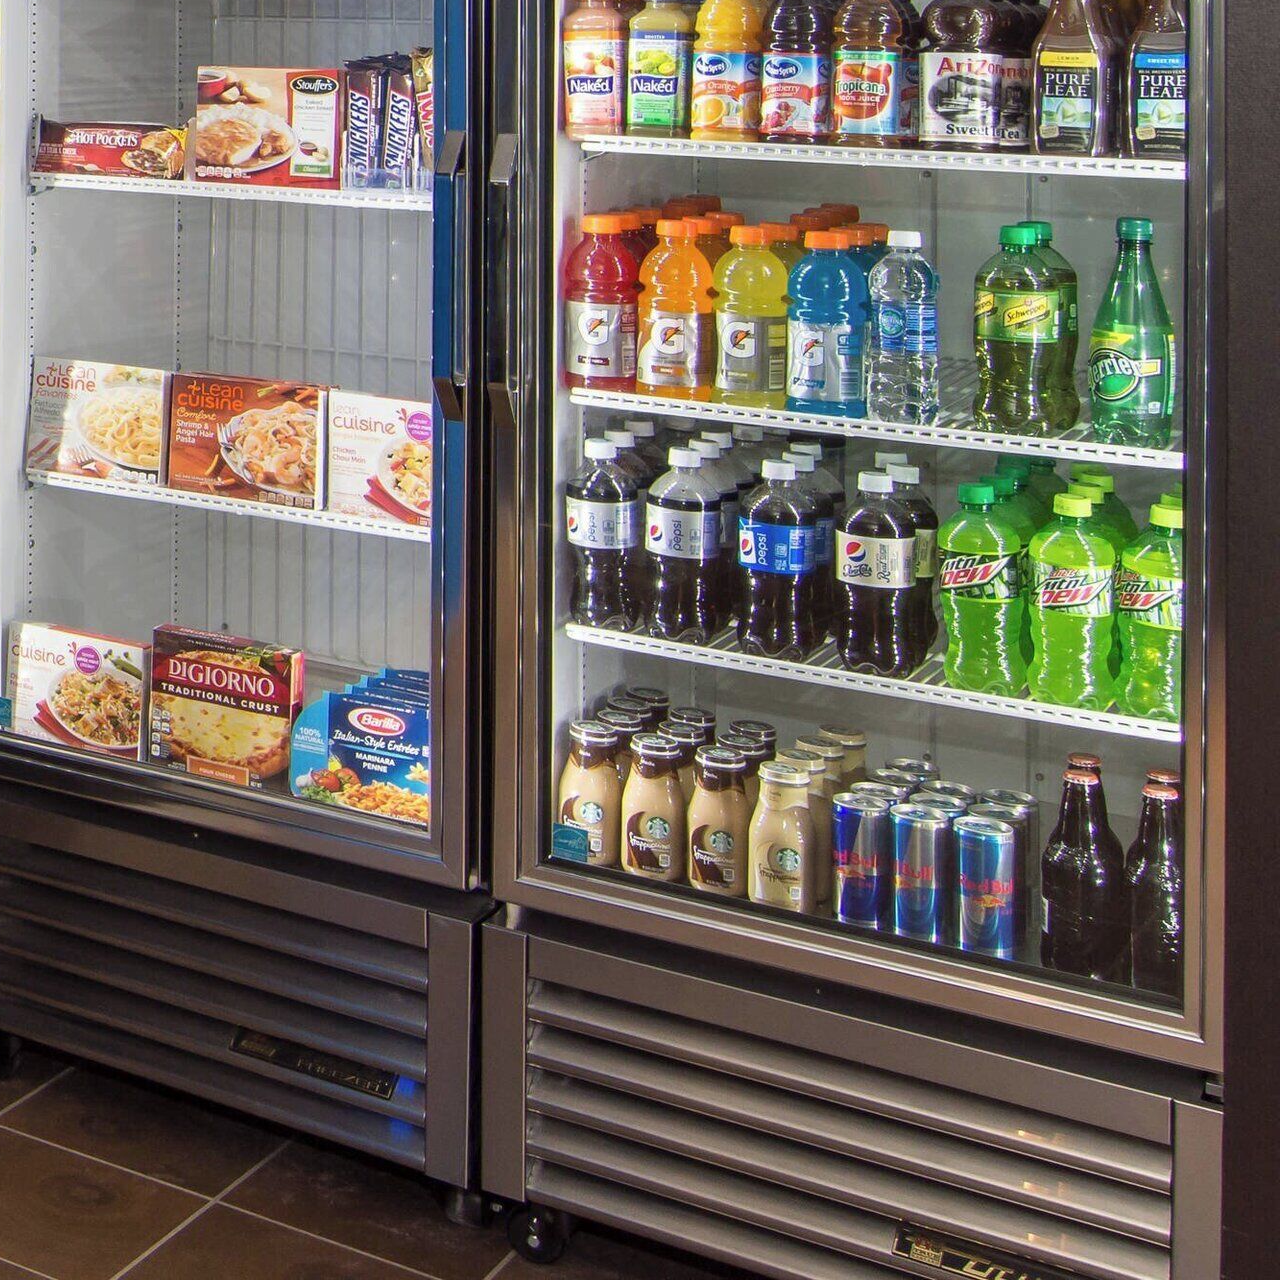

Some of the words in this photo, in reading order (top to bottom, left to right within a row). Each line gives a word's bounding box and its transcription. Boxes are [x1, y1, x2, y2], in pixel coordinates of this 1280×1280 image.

[936, 56, 1002, 77] AriZon
[295, 79, 333, 92] Stouffer's
[707, 80, 737, 92] Orange
[834, 78, 888, 96] Tropicana
[1044, 72, 1091, 86] PURE
[1139, 74, 1187, 87] PURE
[858, 95, 881, 103] JUICE
[1044, 84, 1088, 98] LEAF
[1139, 86, 1184, 99] LEAF
[75, 130, 97, 145] HOT
[96, 132, 138, 147] POCKETS
[349, 91, 370, 175] SNICKERS
[384, 91, 411, 175] SNICKERS
[945, 123, 989, 137] Sweet
[1006, 302, 1048, 322] Schweppes
[577, 309, 609, 346] G
[651, 317, 686, 355] G
[721, 321, 757, 359] G
[794, 330, 825, 367] G
[58, 363, 97, 380] Lean
[1092, 357, 1141, 383] errier
[36, 374, 97, 393] cuisine
[201, 382, 244, 399] Lean
[177, 392, 244, 412] cuisine
[176, 406, 218, 422] Comfort
[176, 419, 203, 430] Shrimp
[176, 428, 199, 438] Angel
[199, 430, 215, 438] Hair
[332, 415, 396, 435] cuisine
[175, 435, 196, 444] Pasta
[672, 519, 684, 552] pepsi
[756, 531, 768, 566] pepsi
[941, 563, 1003, 586] Dew
[1040, 584, 1097, 605] Dew
[11, 644, 66, 667] cuisine
[168, 658, 276, 698] DIGIORNO
[160, 682, 237, 706] TRADITIONAL
[240, 699, 280, 715] CRUST
[299, 726, 322, 738] 100%
[360, 713, 401, 732] Barilla
[294, 733, 325, 745] NATURAL
[332, 729, 386, 751] Italian-Style
[355, 752, 396, 767] MARINARA
[362, 761, 388, 774] PENNE
